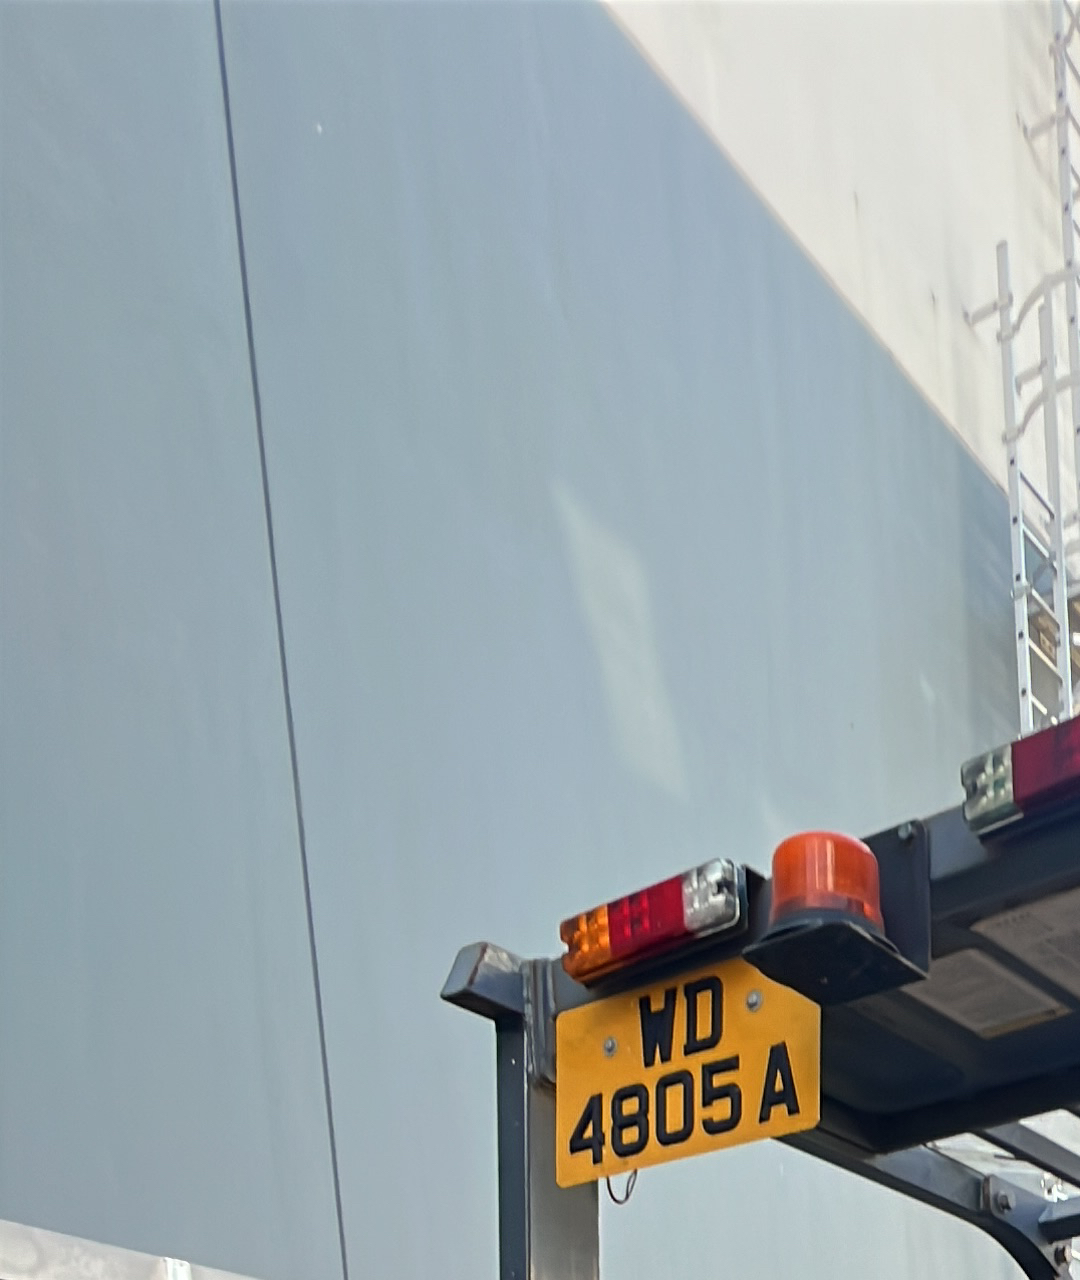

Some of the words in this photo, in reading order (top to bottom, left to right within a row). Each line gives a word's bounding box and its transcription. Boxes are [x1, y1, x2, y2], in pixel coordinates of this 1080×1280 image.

[638, 975, 724, 1069] WD
[568, 1055, 743, 1166] 4805
[758, 1040, 801, 1125] A
